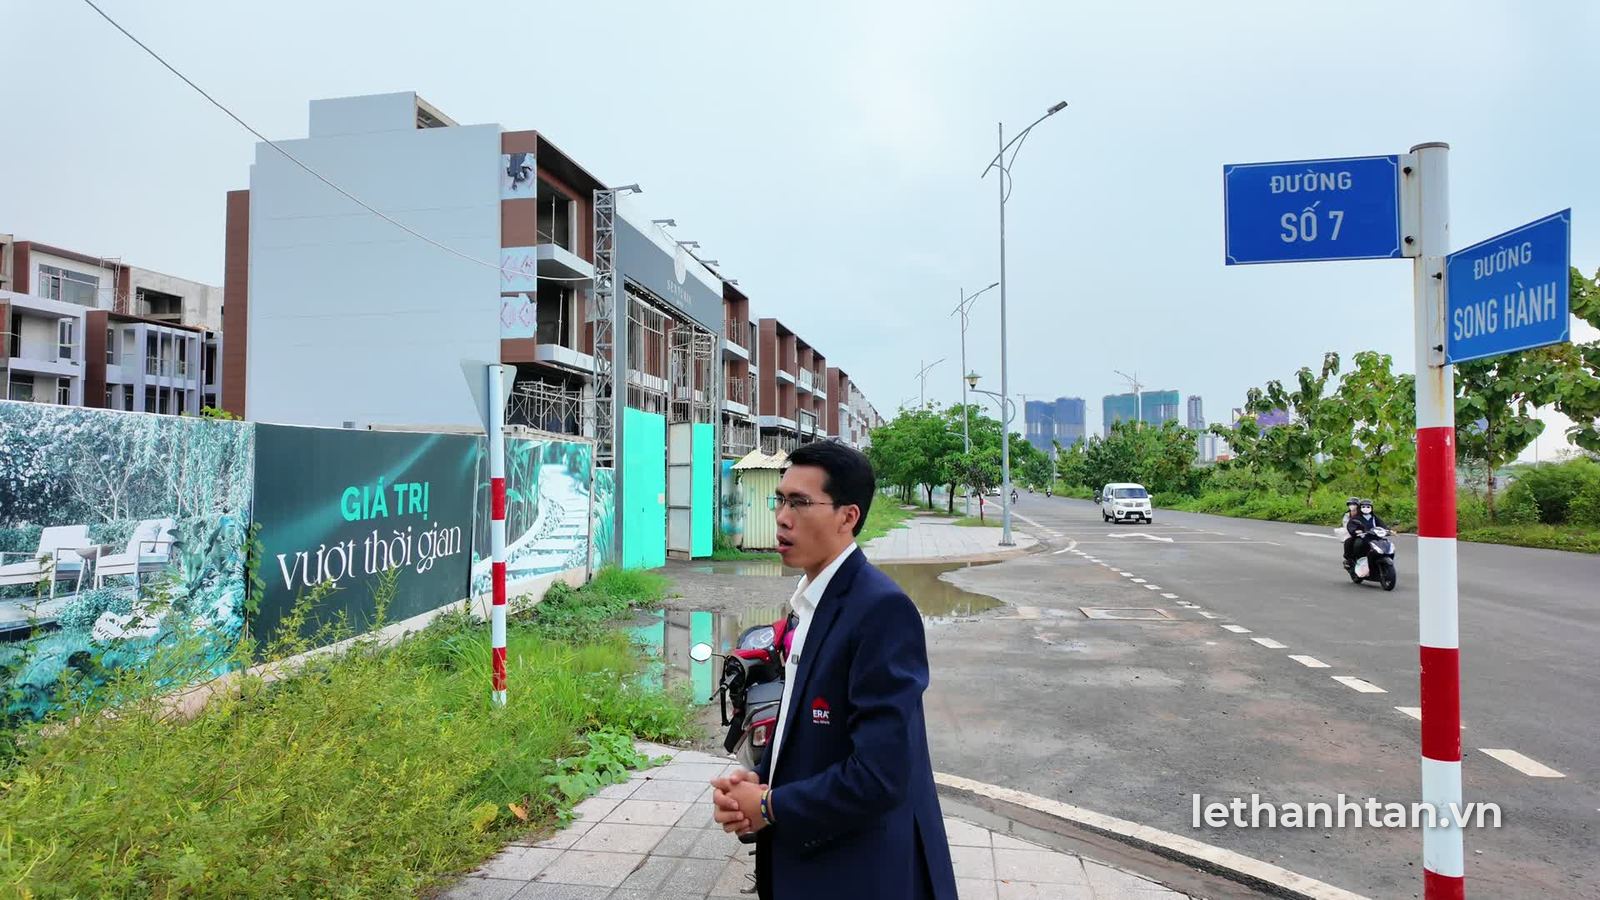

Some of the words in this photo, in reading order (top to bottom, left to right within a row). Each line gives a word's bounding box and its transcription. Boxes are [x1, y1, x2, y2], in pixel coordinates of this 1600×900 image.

[1270, 169, 1352, 194] ĐƯỜNG
[1280, 201, 1320, 243] SỐ
[1329, 210, 1344, 241] 7
[1473, 241, 1532, 281] ĐƯỜNG
[1453, 298, 1498, 341] SONG
[1504, 281, 1556, 330] HÀNH
[340, 476, 389, 522] GIÁ
[393, 481, 429, 521] TRỊ
[276, 539, 356, 590] vượt
[364, 525, 412, 574] thời
[416, 521, 461, 574] gian
[812, 709, 829, 719] ERA
